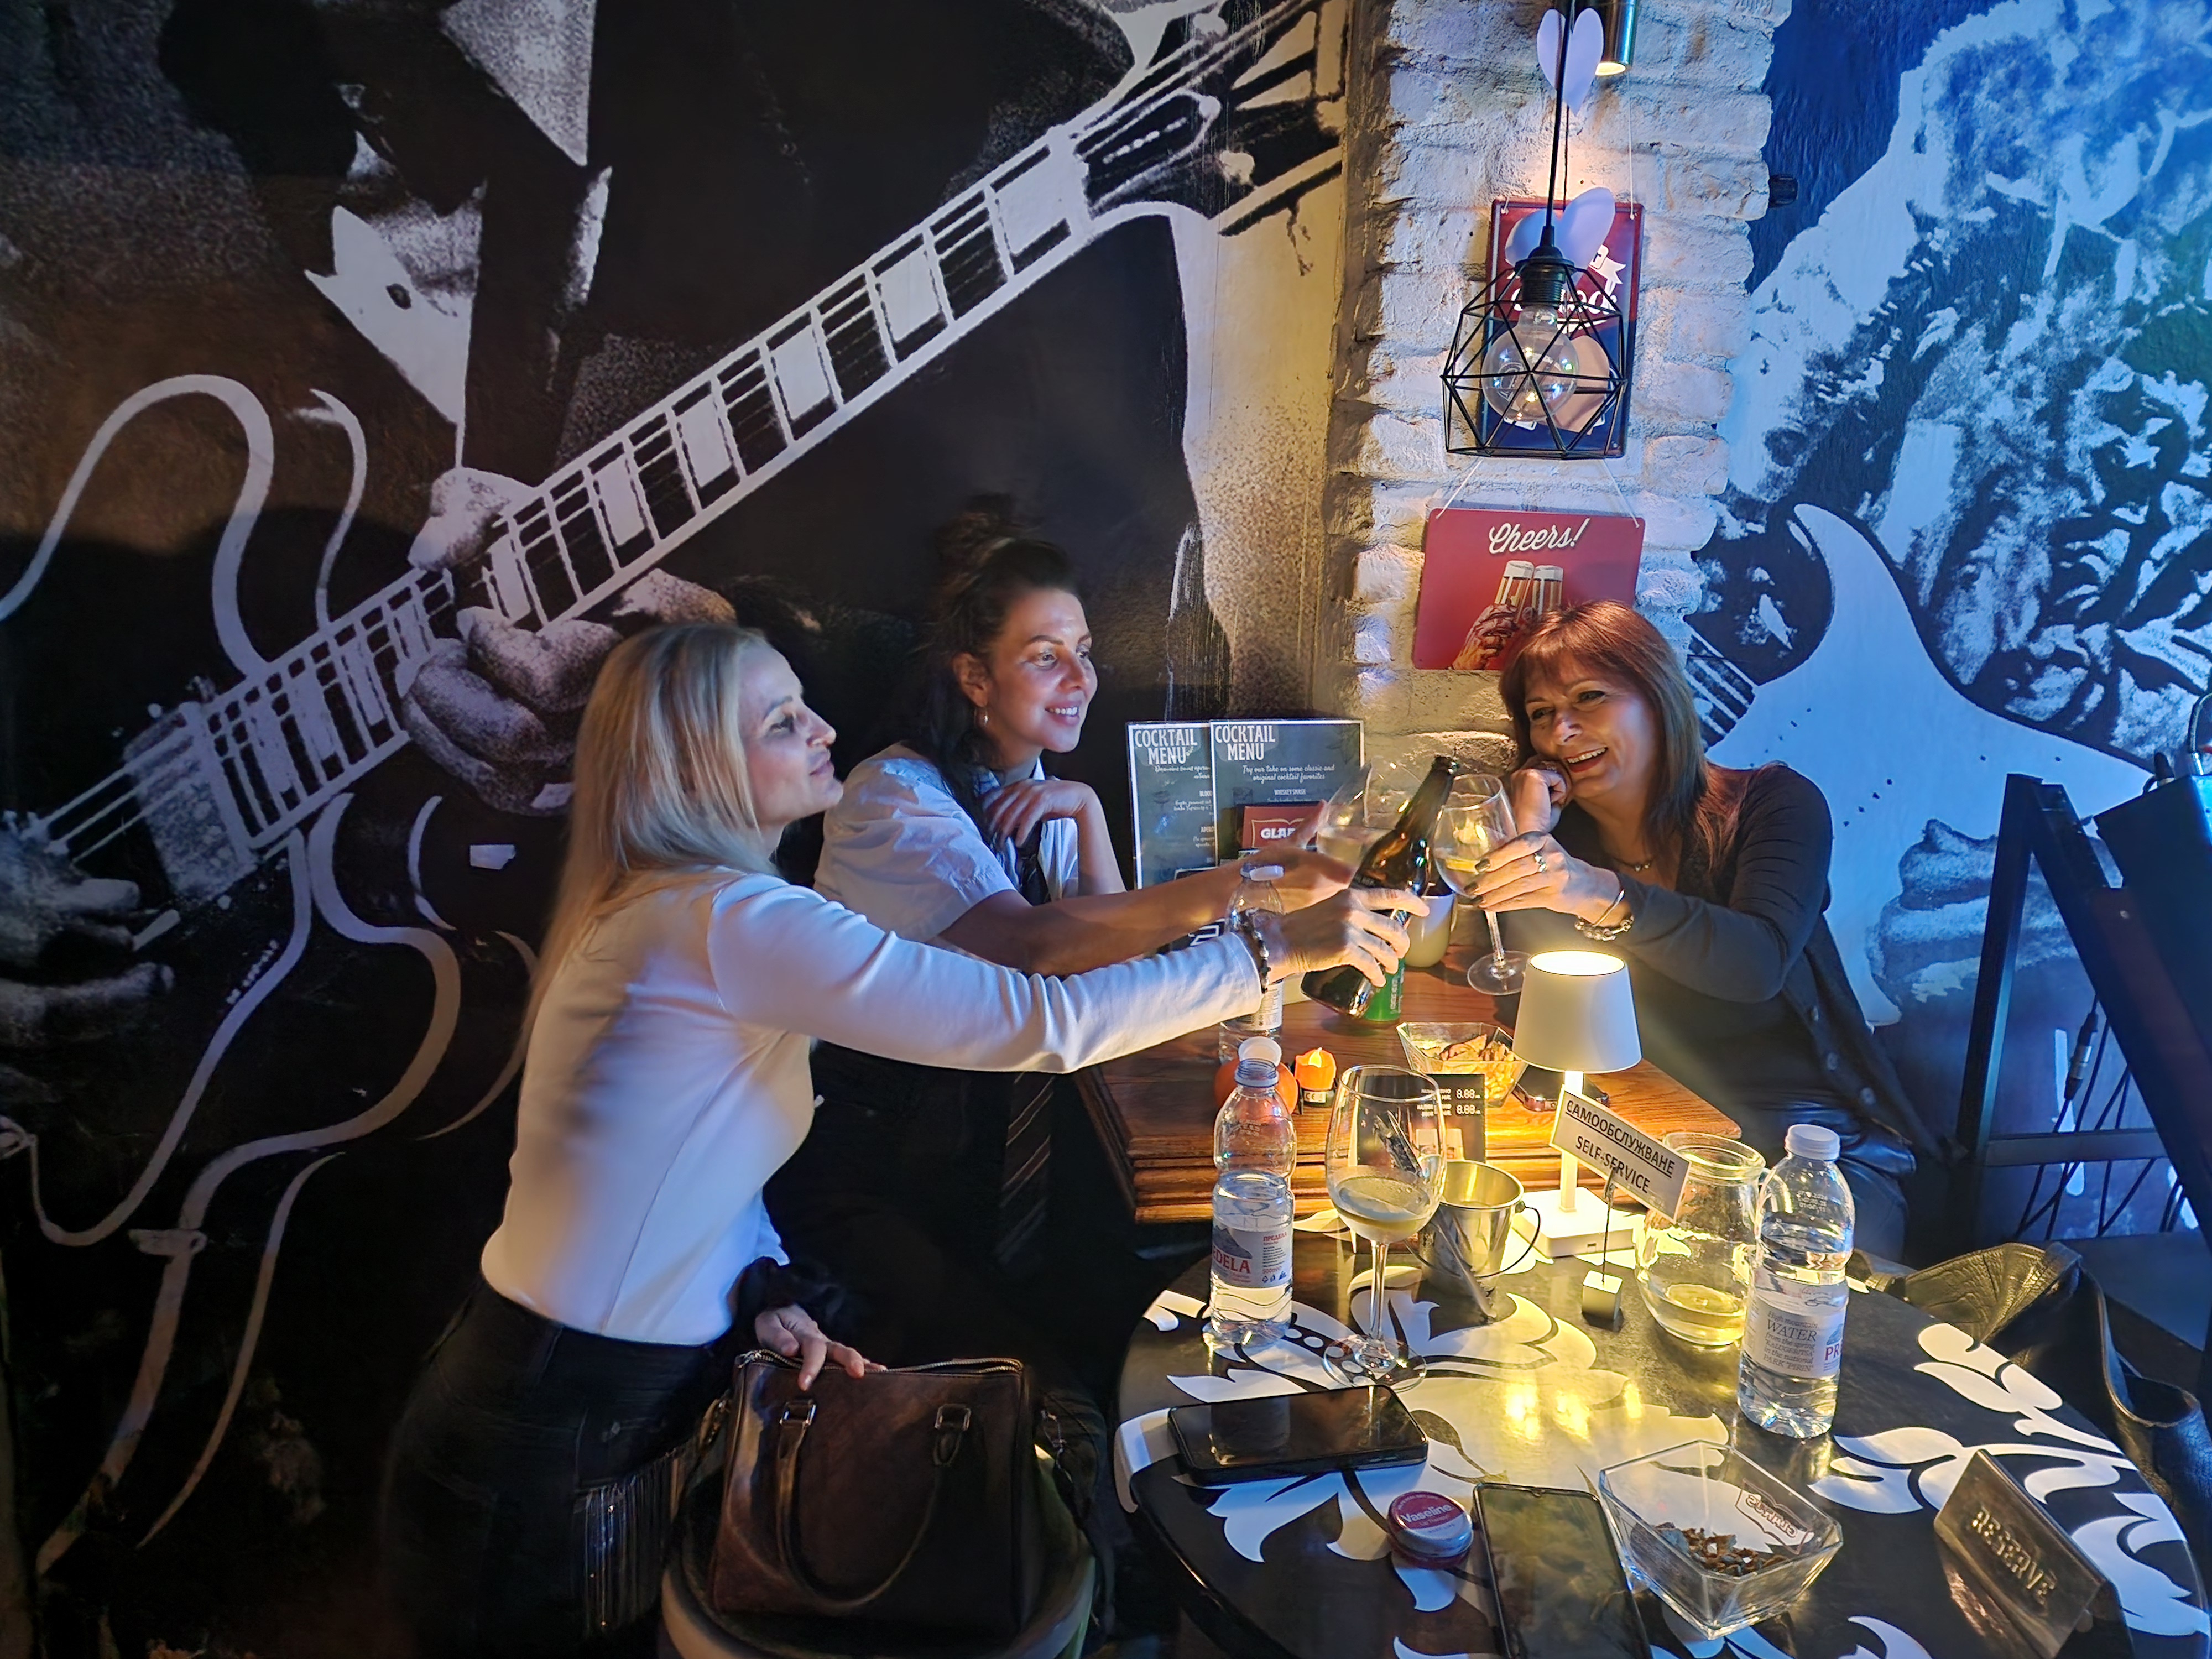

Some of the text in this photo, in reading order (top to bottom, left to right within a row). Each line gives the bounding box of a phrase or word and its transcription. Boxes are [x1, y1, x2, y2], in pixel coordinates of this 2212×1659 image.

[1489, 517, 1590, 554] Cheers!
[1135, 728, 1198, 747] COCKTAIL
[1215, 724, 1276, 743] COCKTAIL
[1148, 746, 1187, 765] MENU
[1227, 743, 1265, 761] MENU
[1243, 765, 1253, 775] Try
[1253, 774, 1276, 784] original
[1300, 773, 1325, 784] favorites
[1575, 1135, 1650, 1193] SELF-SERVICE
[1767, 1319, 1818, 1342] WATER
[1764, 1353, 1785, 1367] PARK
[1400, 1504, 1452, 1522] Vaseline
